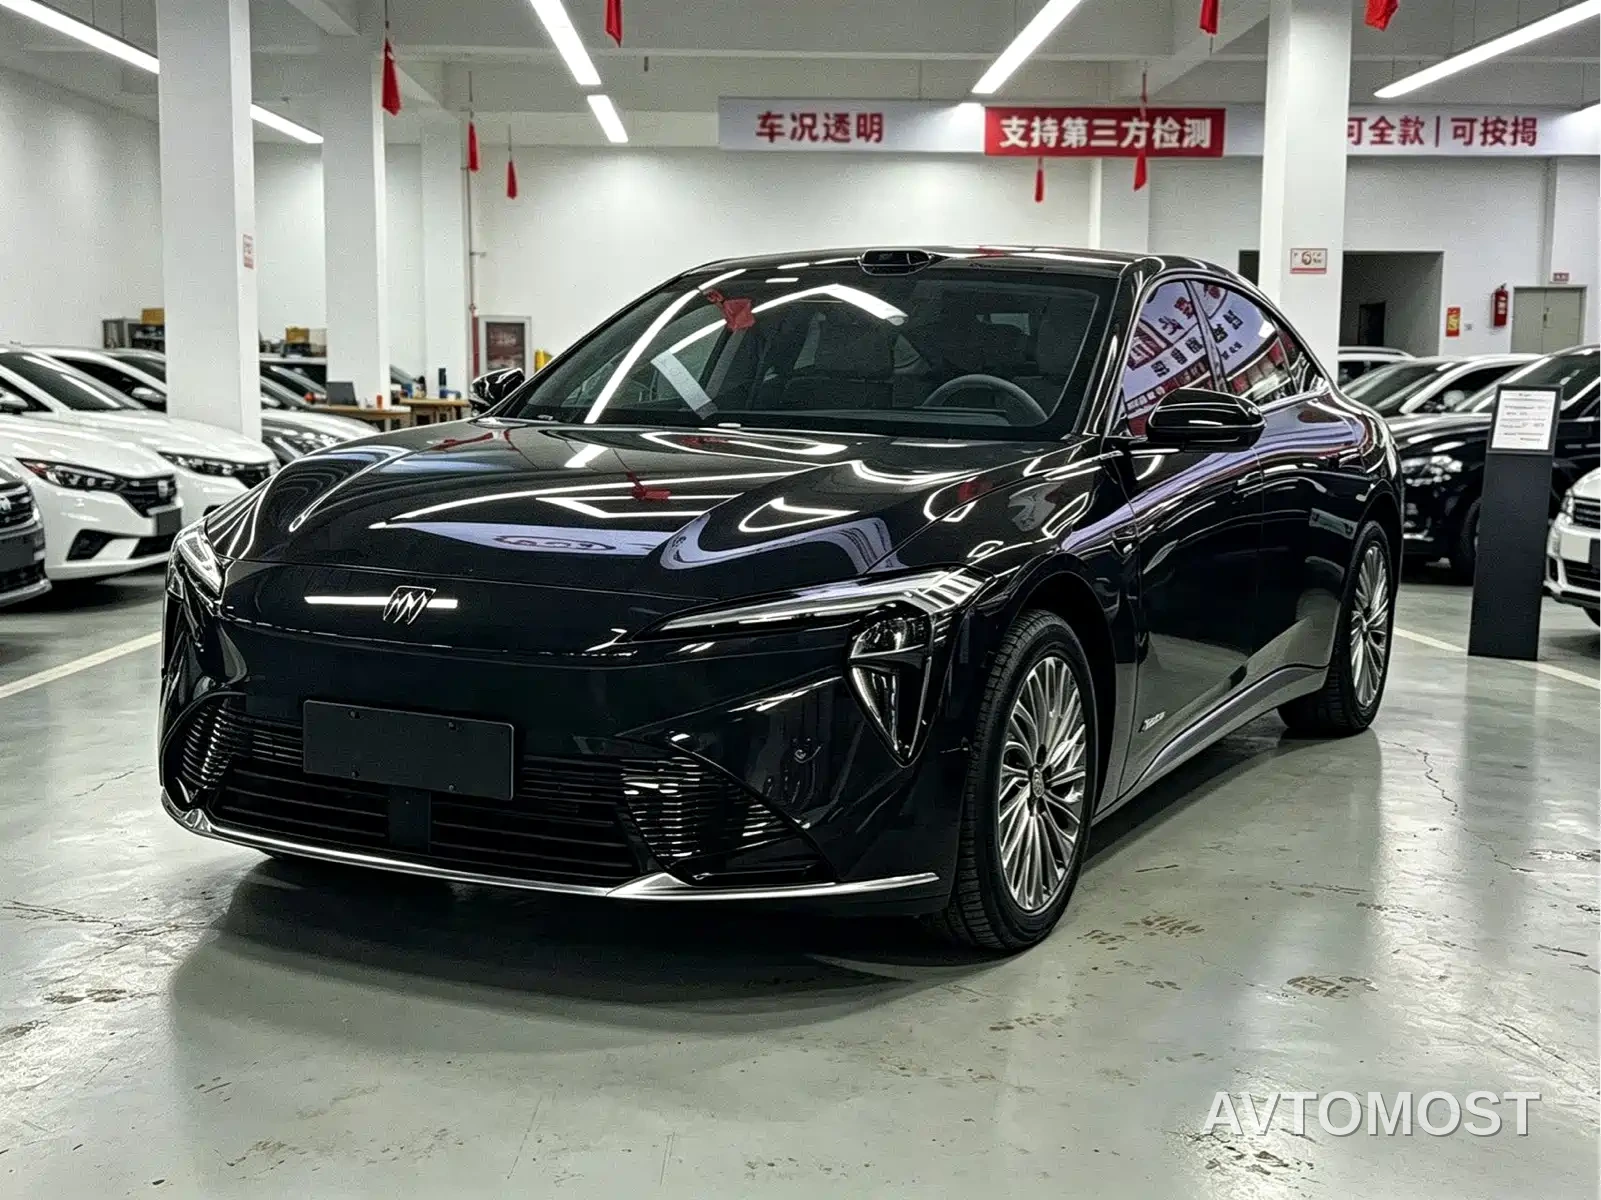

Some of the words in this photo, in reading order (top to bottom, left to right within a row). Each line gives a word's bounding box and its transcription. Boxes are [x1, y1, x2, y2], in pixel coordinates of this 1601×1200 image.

[756, 111, 883, 143] 车况透明
[1000, 116, 1212, 149] 支持第三方检测
